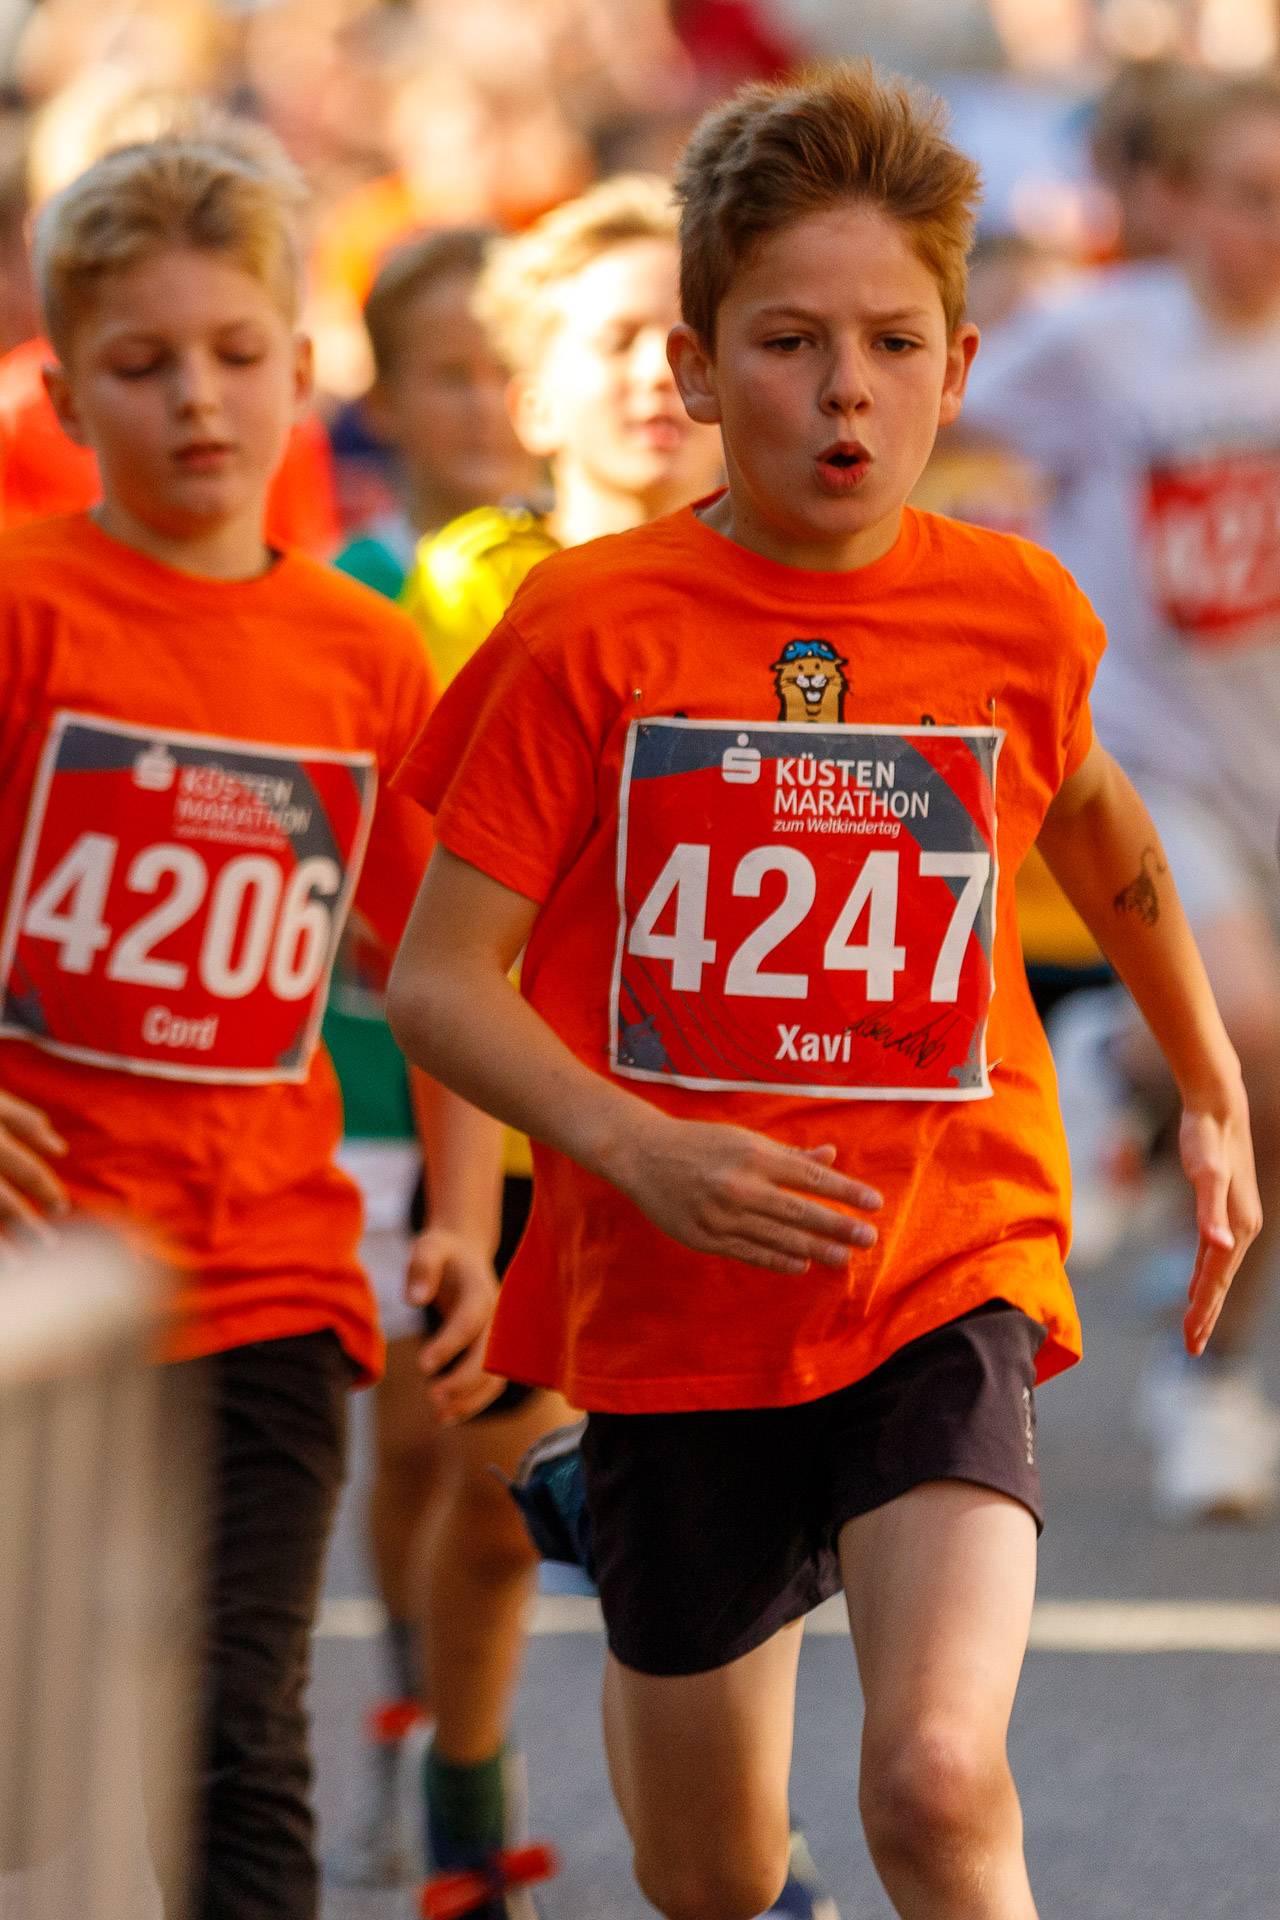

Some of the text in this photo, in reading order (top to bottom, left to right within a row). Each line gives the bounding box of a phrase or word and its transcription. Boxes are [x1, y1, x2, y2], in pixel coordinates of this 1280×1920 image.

[775, 752, 896, 789] KÜSTEN
[773, 788, 930, 819] MARATHON
[772, 817, 901, 839] zum Weltkindertag
[22, 831, 341, 1001] 4206
[627, 842, 991, 1003] 4247
[141, 1005, 219, 1051] Cord
[775, 1024, 852, 1063] Xavi
